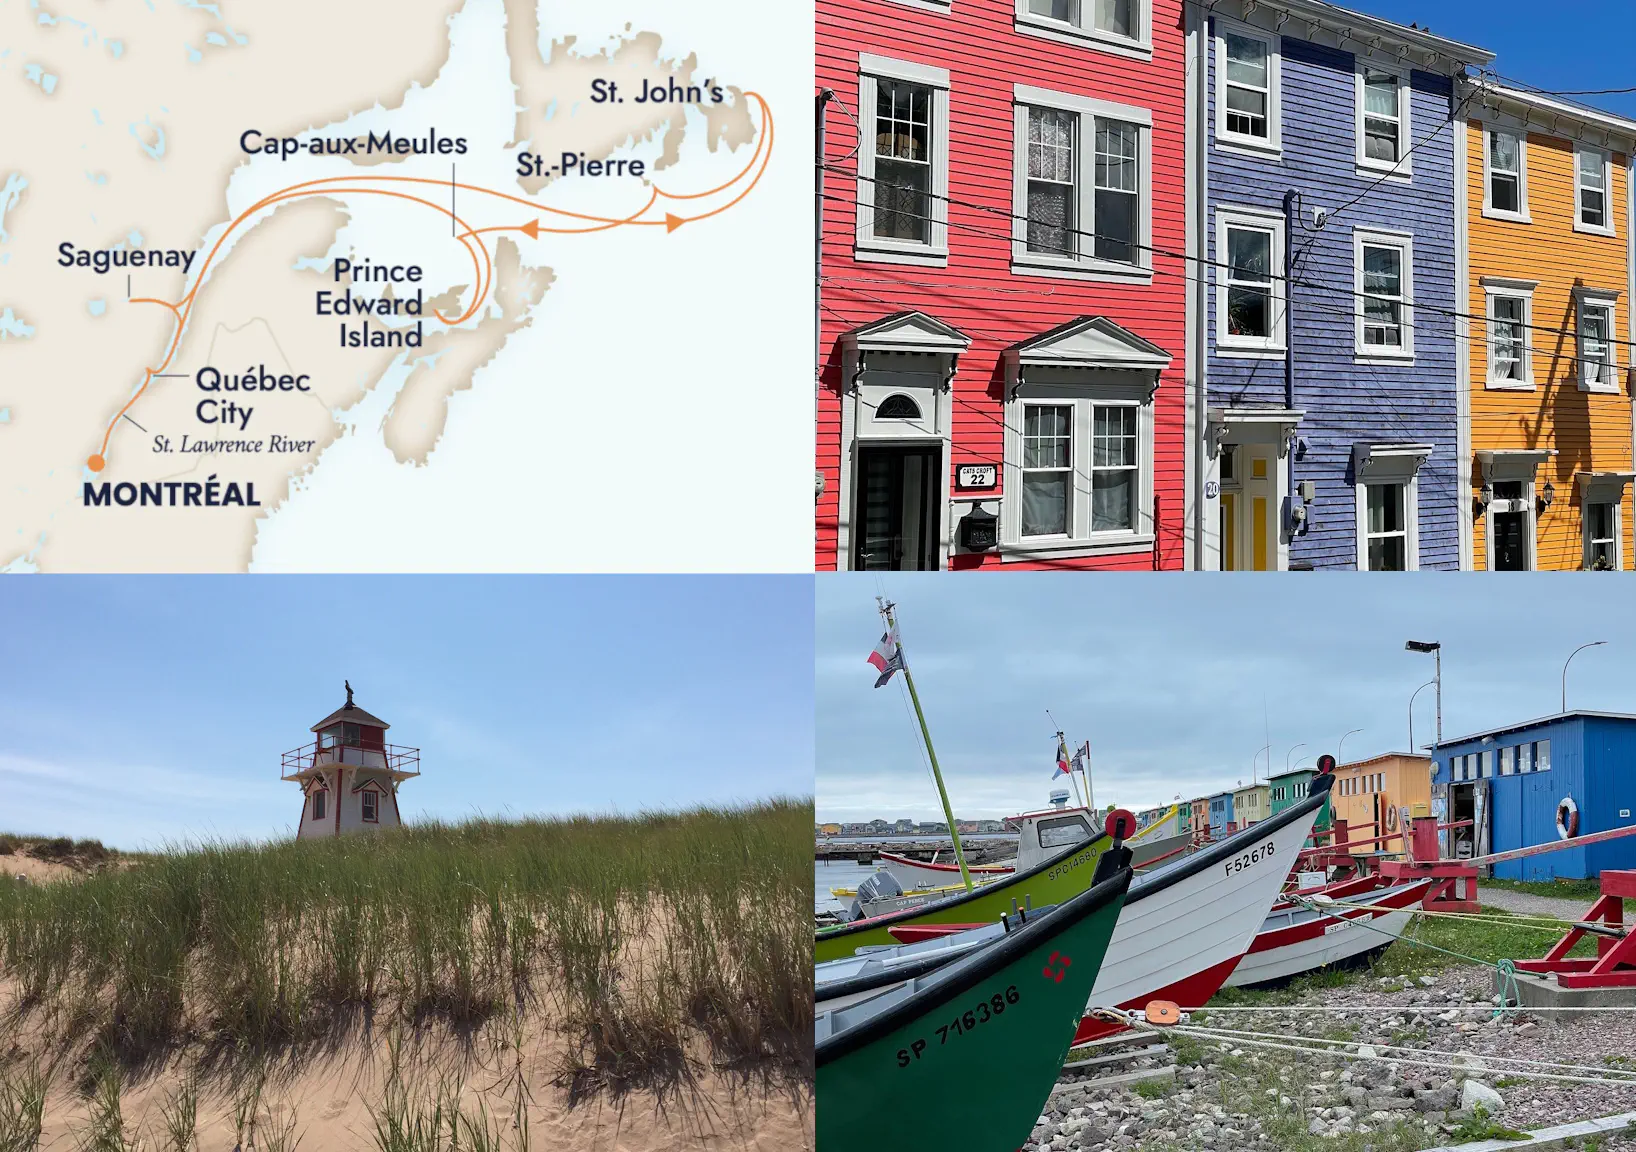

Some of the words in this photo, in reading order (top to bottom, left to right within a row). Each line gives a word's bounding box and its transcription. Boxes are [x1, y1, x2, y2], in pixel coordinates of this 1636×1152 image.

[590, 78, 624, 103] St.
[634, 76, 724, 103] John's
[240, 127, 468, 161] Cap-aux-Meules
[516, 152, 645, 177] St.-Pierre
[57, 243, 196, 274] Saguenay
[334, 258, 423, 283] Prince
[316, 289, 422, 316] Edward
[340, 321, 422, 348] Island
[196, 364, 311, 392] Québec
[196, 399, 254, 431] City
[152, 434, 174, 453] St.
[180, 434, 263, 453] Lawrence
[267, 434, 316, 453] River
[83, 473, 261, 507] MONTRÉAL
[970, 474, 985, 485] 22
[1207, 482, 1219, 496] 20
[1048, 847, 1097, 881] SPC14680
[1225, 841, 1275, 877] F52678
[896, 1038, 927, 1068] SP
[934, 985, 1020, 1045] 716386
